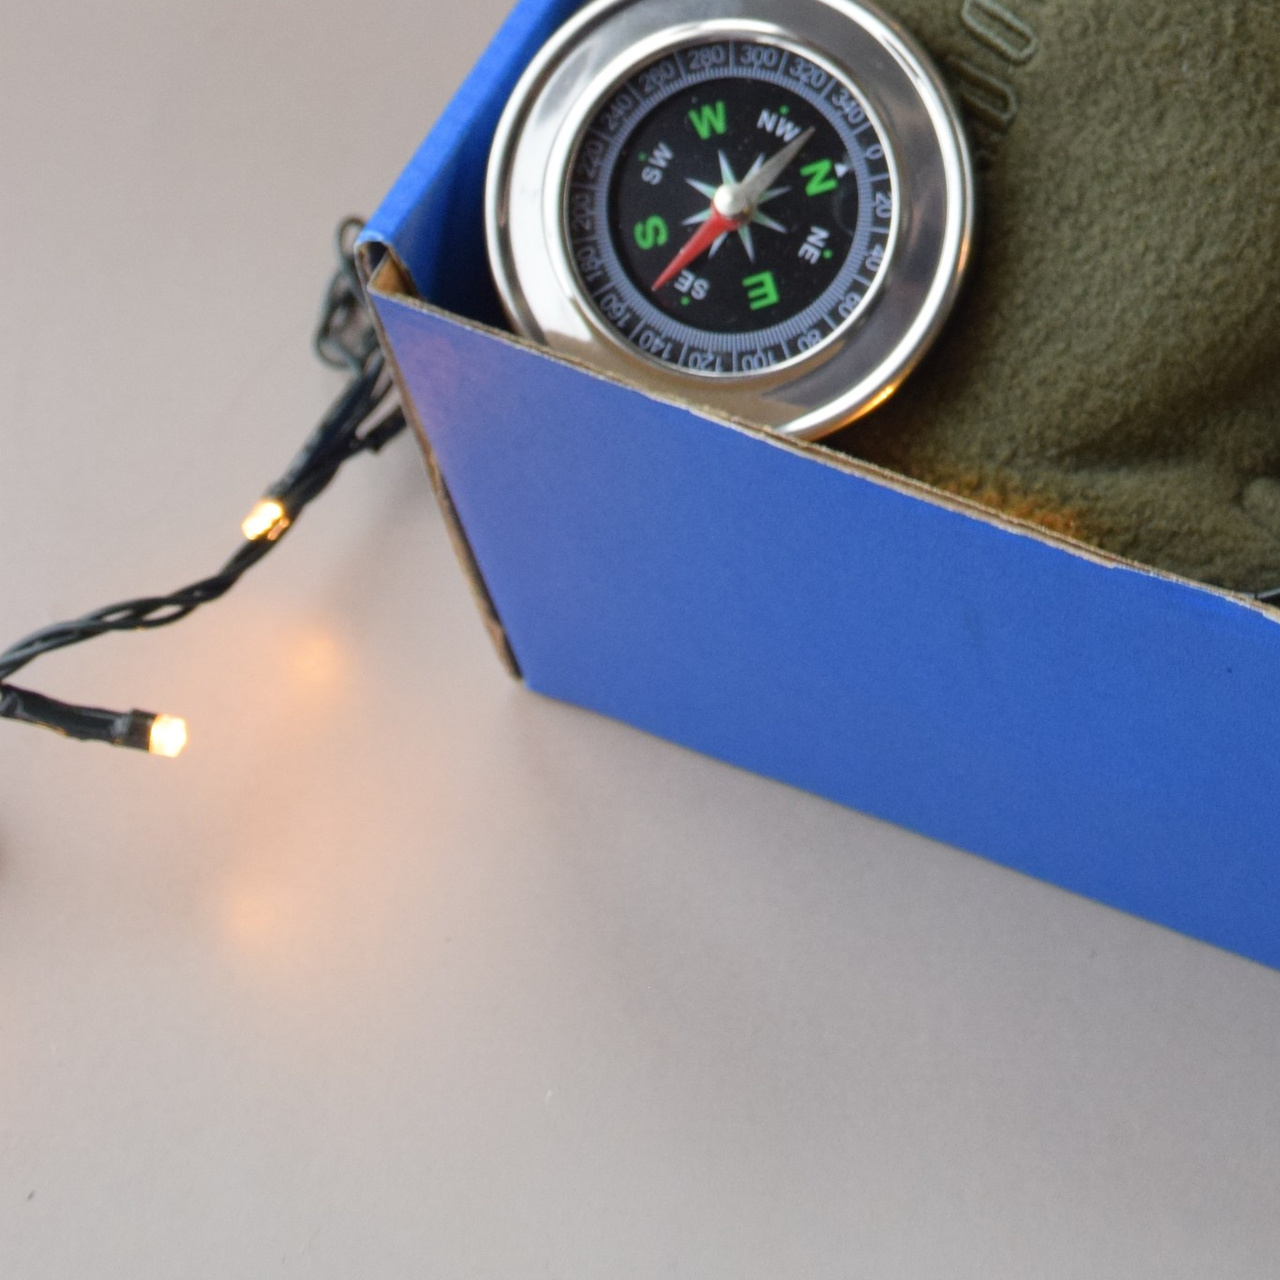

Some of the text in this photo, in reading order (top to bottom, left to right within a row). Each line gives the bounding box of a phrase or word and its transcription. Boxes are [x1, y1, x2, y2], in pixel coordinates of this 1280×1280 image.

[689, 44, 725, 69] 280
[740, 45, 778, 68] 300
[788, 57, 826, 89] 320
[641, 58, 676, 90] 260
[602, 92, 633, 130] 240
[688, 99, 729, 141] W
[830, 83, 866, 124] 340
[756, 108, 801, 143] NW
[641, 142, 673, 186] SW
[864, 142, 885, 161] 0
[799, 157, 840, 198] N
[873, 191, 893, 221] 20
[633, 214, 669, 251] S
[798, 226, 830, 264] NE
[579, 239, 605, 282] 180
[864, 241, 886, 271] 40
[672, 269, 711, 301] SE
[741, 271, 781, 311] E
[600, 295, 632, 332] 160
[837, 291, 861, 321] 60
[638, 328, 675, 362] 140
[796, 327, 824, 354] 80
[687, 347, 726, 373] 120
[740, 348, 780, 372] 100
